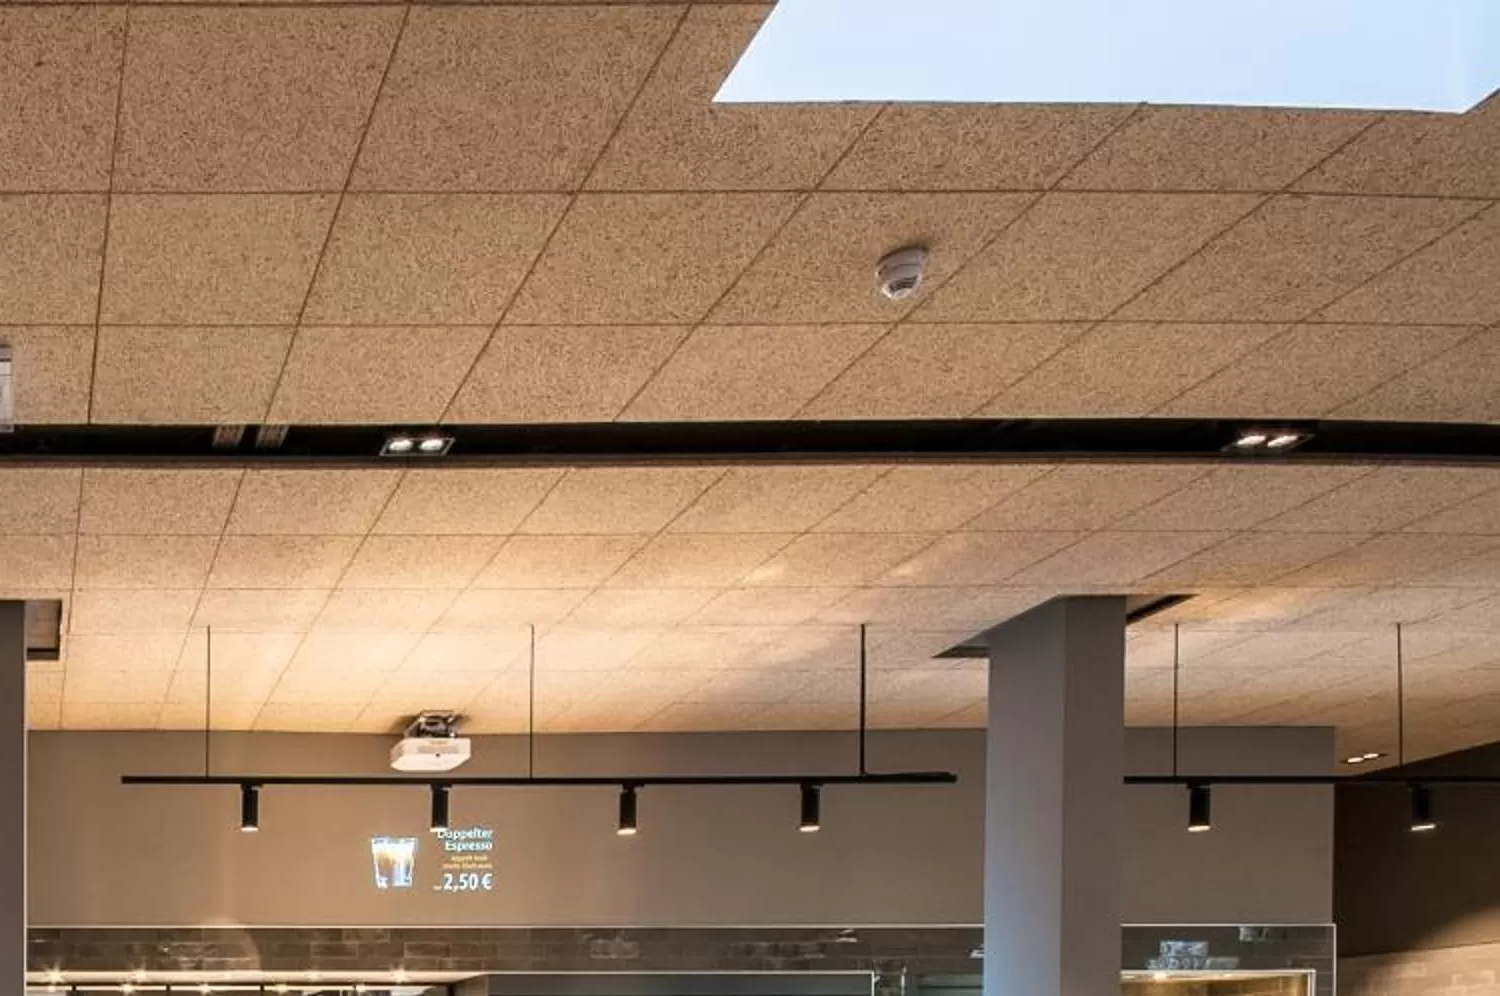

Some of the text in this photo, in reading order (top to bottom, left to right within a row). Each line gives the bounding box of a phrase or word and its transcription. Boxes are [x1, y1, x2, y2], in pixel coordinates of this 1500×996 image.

[445, 841, 493, 853] Espresso
[443, 873, 494, 892] 2,50 €
